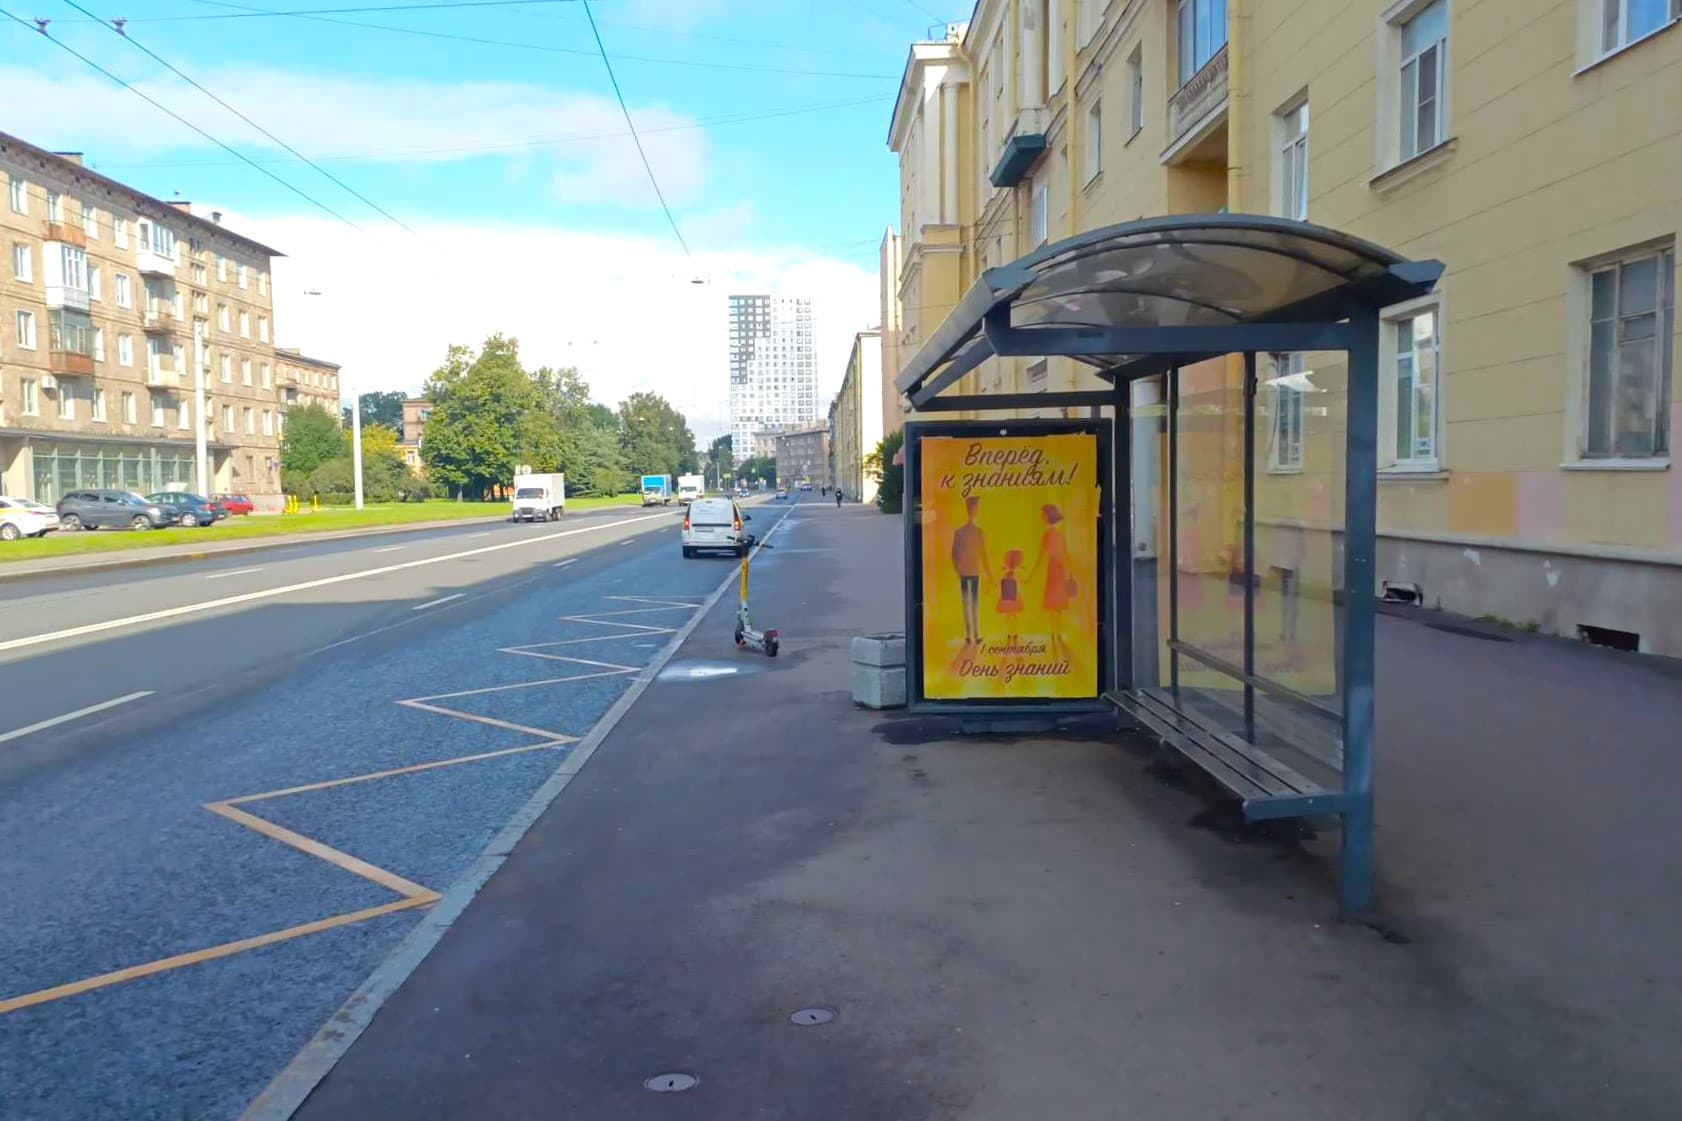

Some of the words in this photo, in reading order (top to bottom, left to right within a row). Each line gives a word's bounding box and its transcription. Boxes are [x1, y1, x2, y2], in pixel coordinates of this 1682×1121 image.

[961, 463, 1079, 497] знаниям!
[988, 641, 1047, 656] сентября
[959, 659, 999, 677] День
[1004, 660, 1071, 684] знаний
